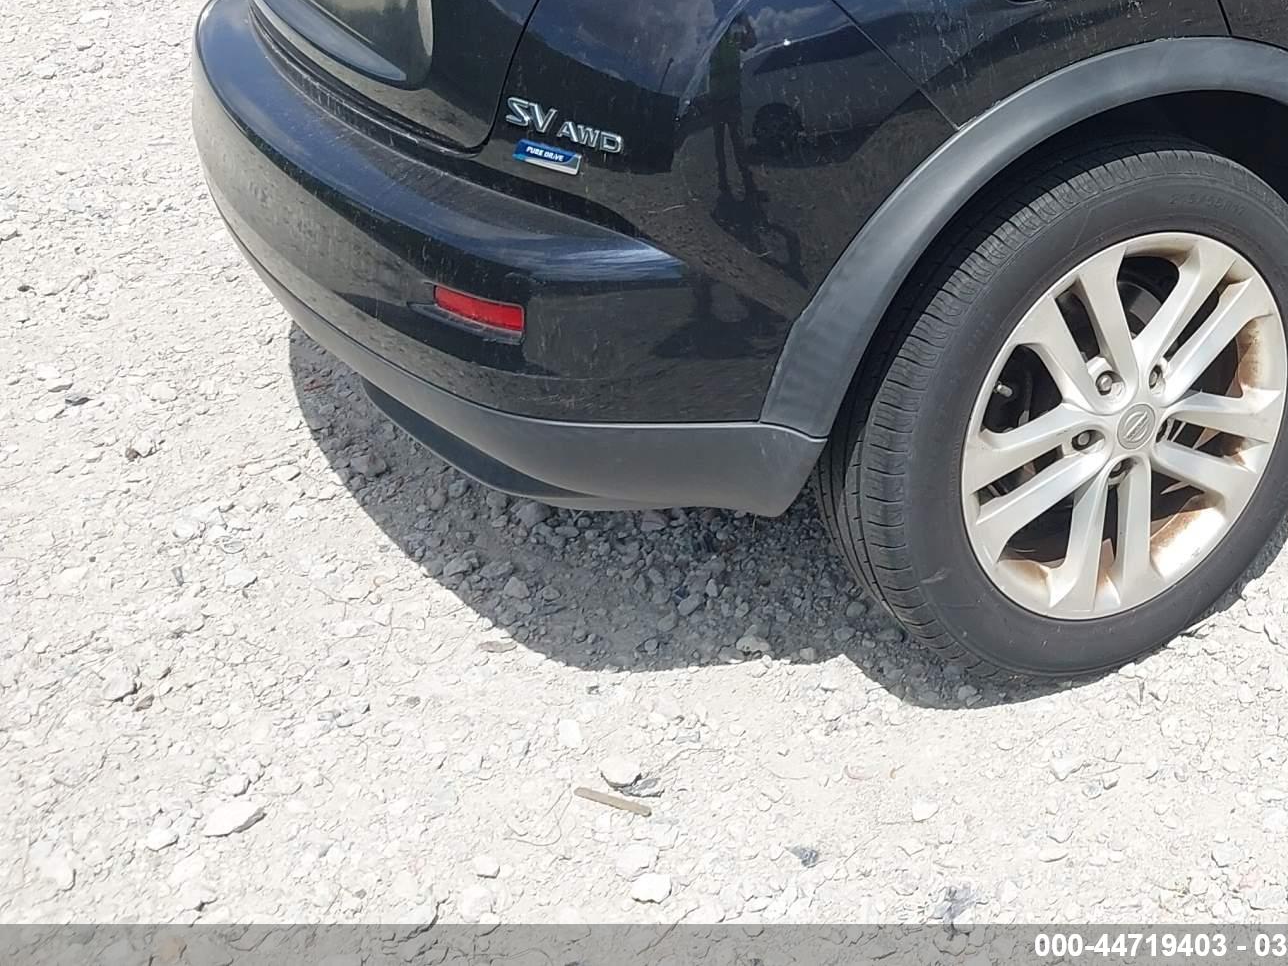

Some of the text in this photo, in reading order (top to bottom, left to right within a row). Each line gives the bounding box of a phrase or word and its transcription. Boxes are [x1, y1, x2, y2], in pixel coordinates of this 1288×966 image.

[505, 96, 625, 154] SV AWD
[543, 149, 565, 162] DRIVE
